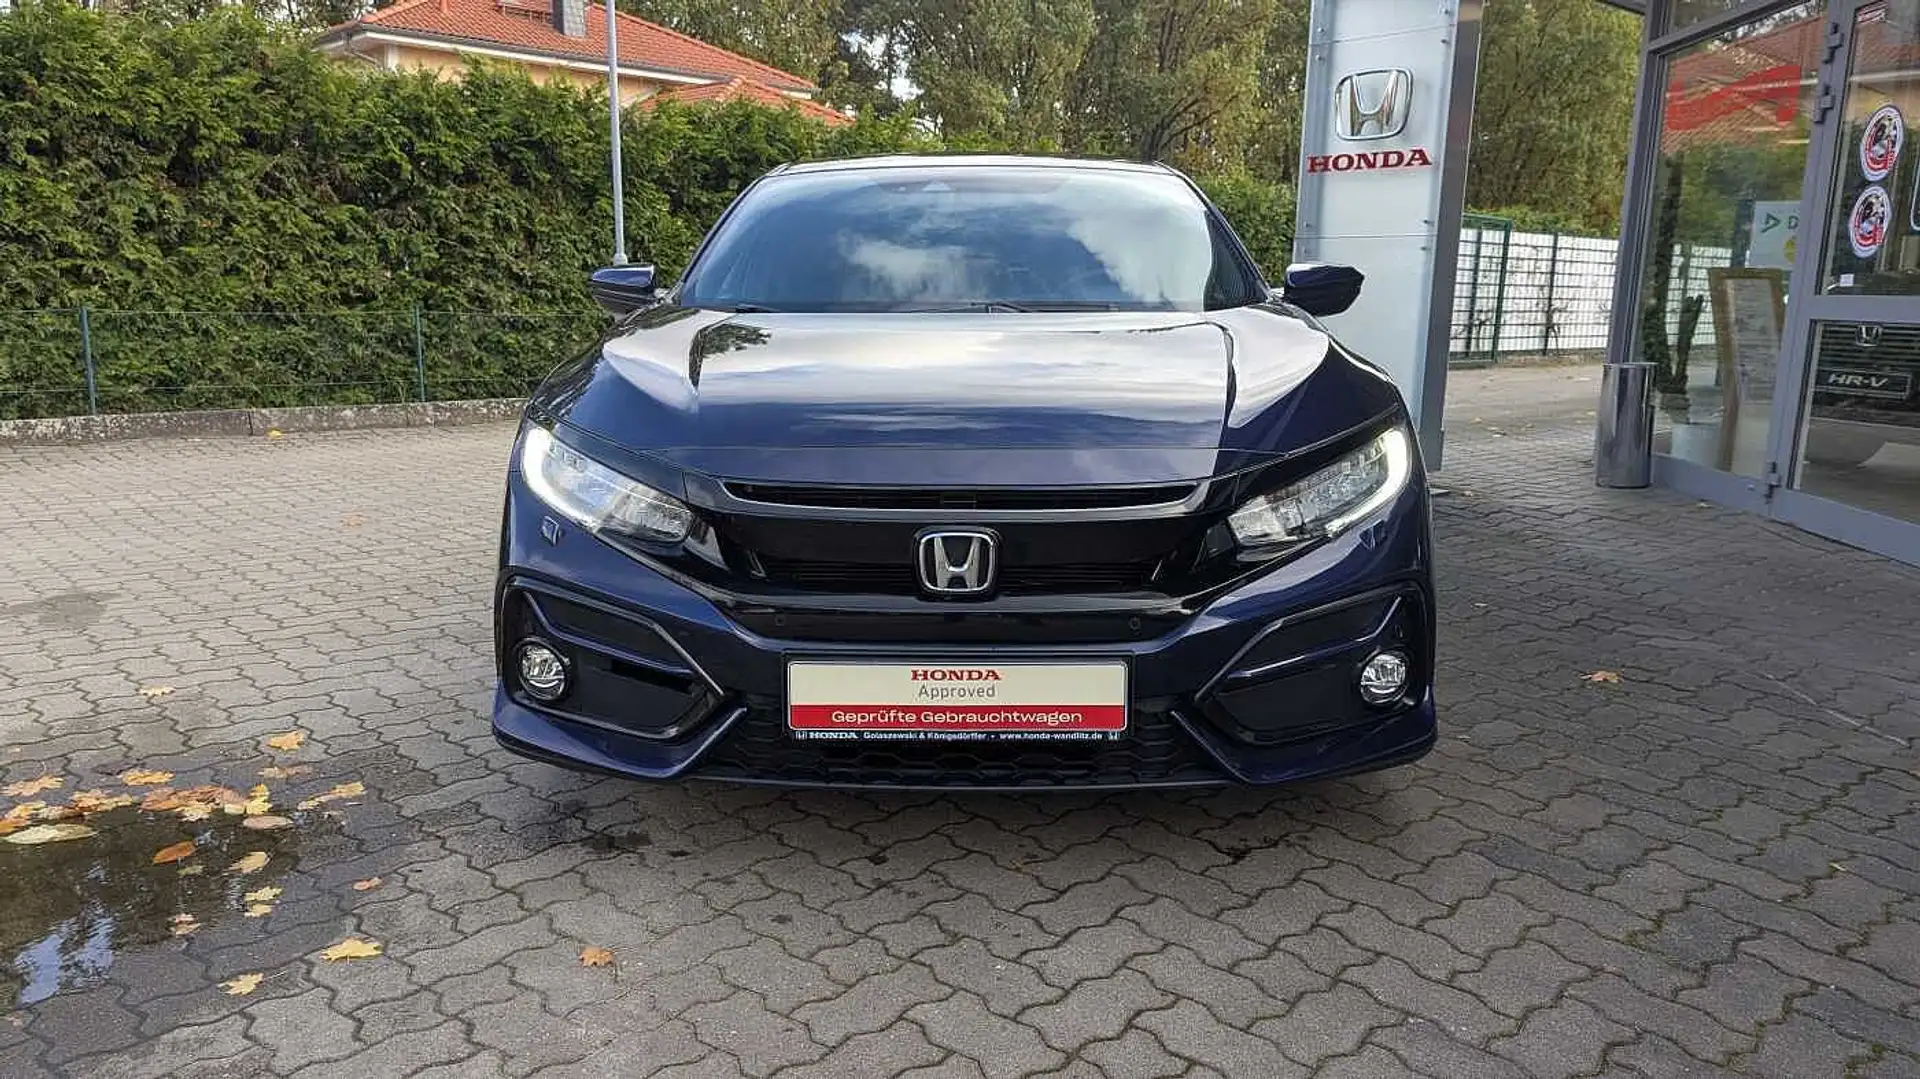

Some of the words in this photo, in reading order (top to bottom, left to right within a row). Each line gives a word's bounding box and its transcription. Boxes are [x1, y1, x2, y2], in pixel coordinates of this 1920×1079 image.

[1307, 149, 1432, 173] HONDA
[1828, 373, 1888, 387] HR-V
[911, 669, 1001, 681] HONDA
[918, 684, 995, 700] Approved
[831, 710, 917, 725] Geprüfte
[921, 710, 1083, 726] Gebrauchtwagen
[809, 731, 858, 739] HONDA
[918, 731, 926, 740] &
[927, 731, 987, 742] Königsdörffer
[1000, 731, 1103, 740] www.honda-wandlitz.de
